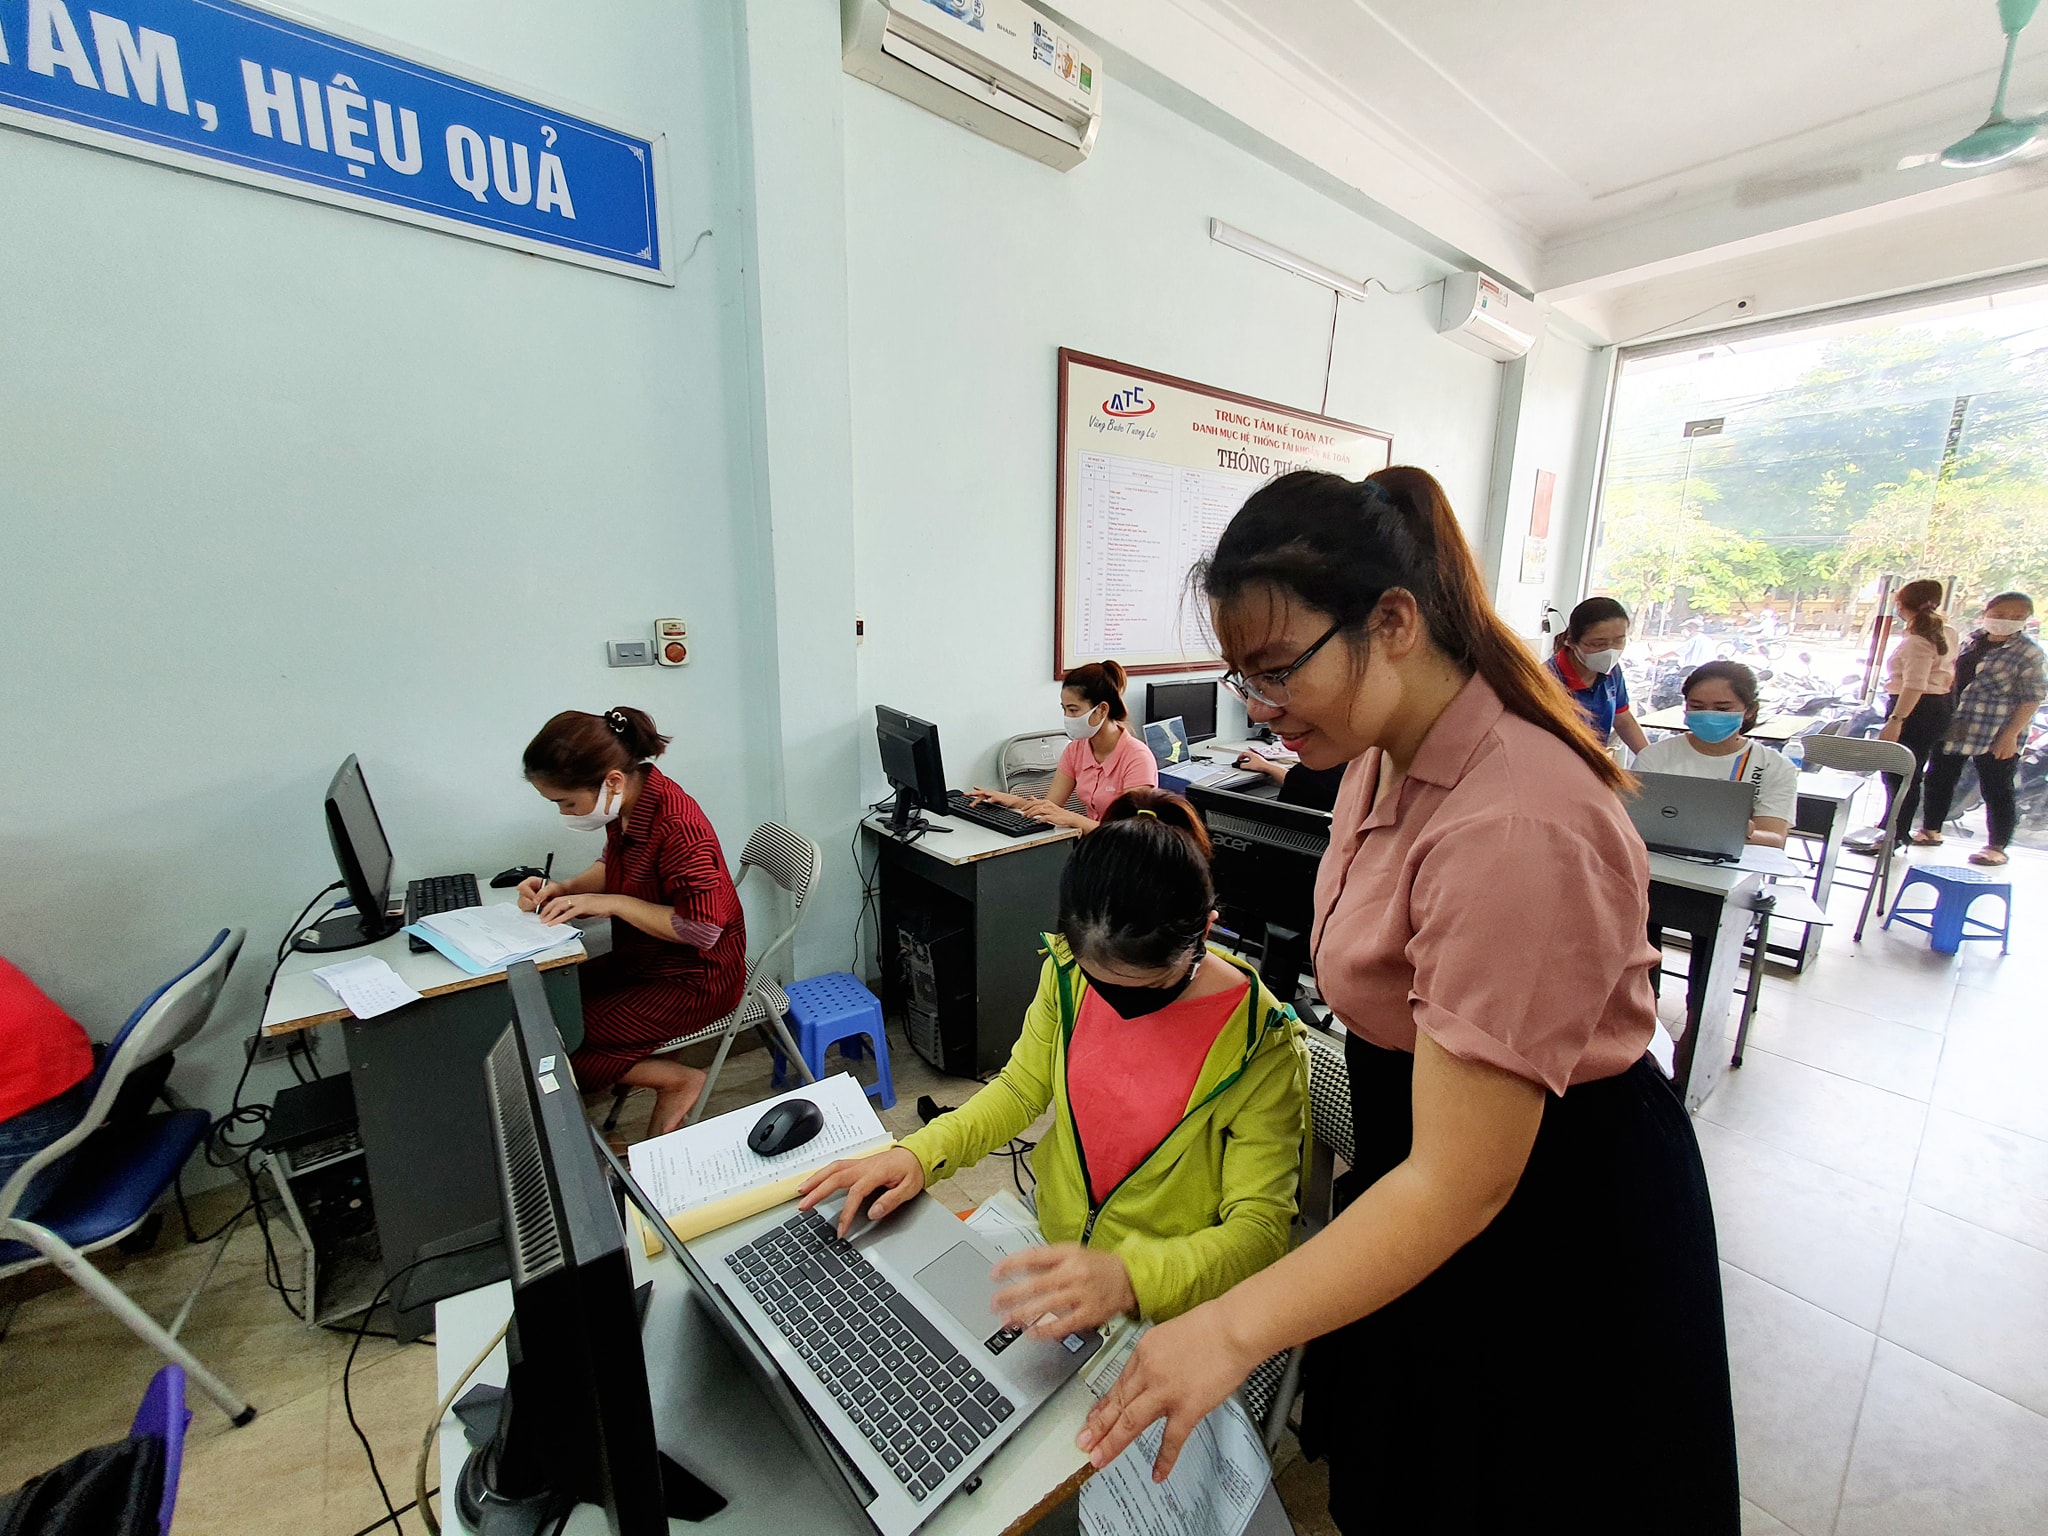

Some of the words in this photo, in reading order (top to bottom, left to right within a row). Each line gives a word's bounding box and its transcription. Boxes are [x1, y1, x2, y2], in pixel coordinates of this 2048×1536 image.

[1033, 21, 1042, 36] 10
[1032, 46, 1038, 60] 5
[241, 58, 424, 179] HIỆU
[444, 124, 577, 220] QUẢ
[1110, 386, 1144, 411] ATC
[1192, 422, 1218, 436] DANH
[1220, 428, 1238, 441] MỤC
[1240, 432, 1250, 445] HỆ
[1253, 434, 1280, 449] THỐNG
[1215, 409, 1251, 427] TRUNG
[1254, 418, 1275, 432] TÂM
[1276, 422, 1290, 436] KẾ
[1291, 428, 1317, 442] TOÁN
[1318, 434, 1336, 446] ATC
[1217, 447, 1270, 475] THÔNG
[1212, 832, 1252, 852] acer
